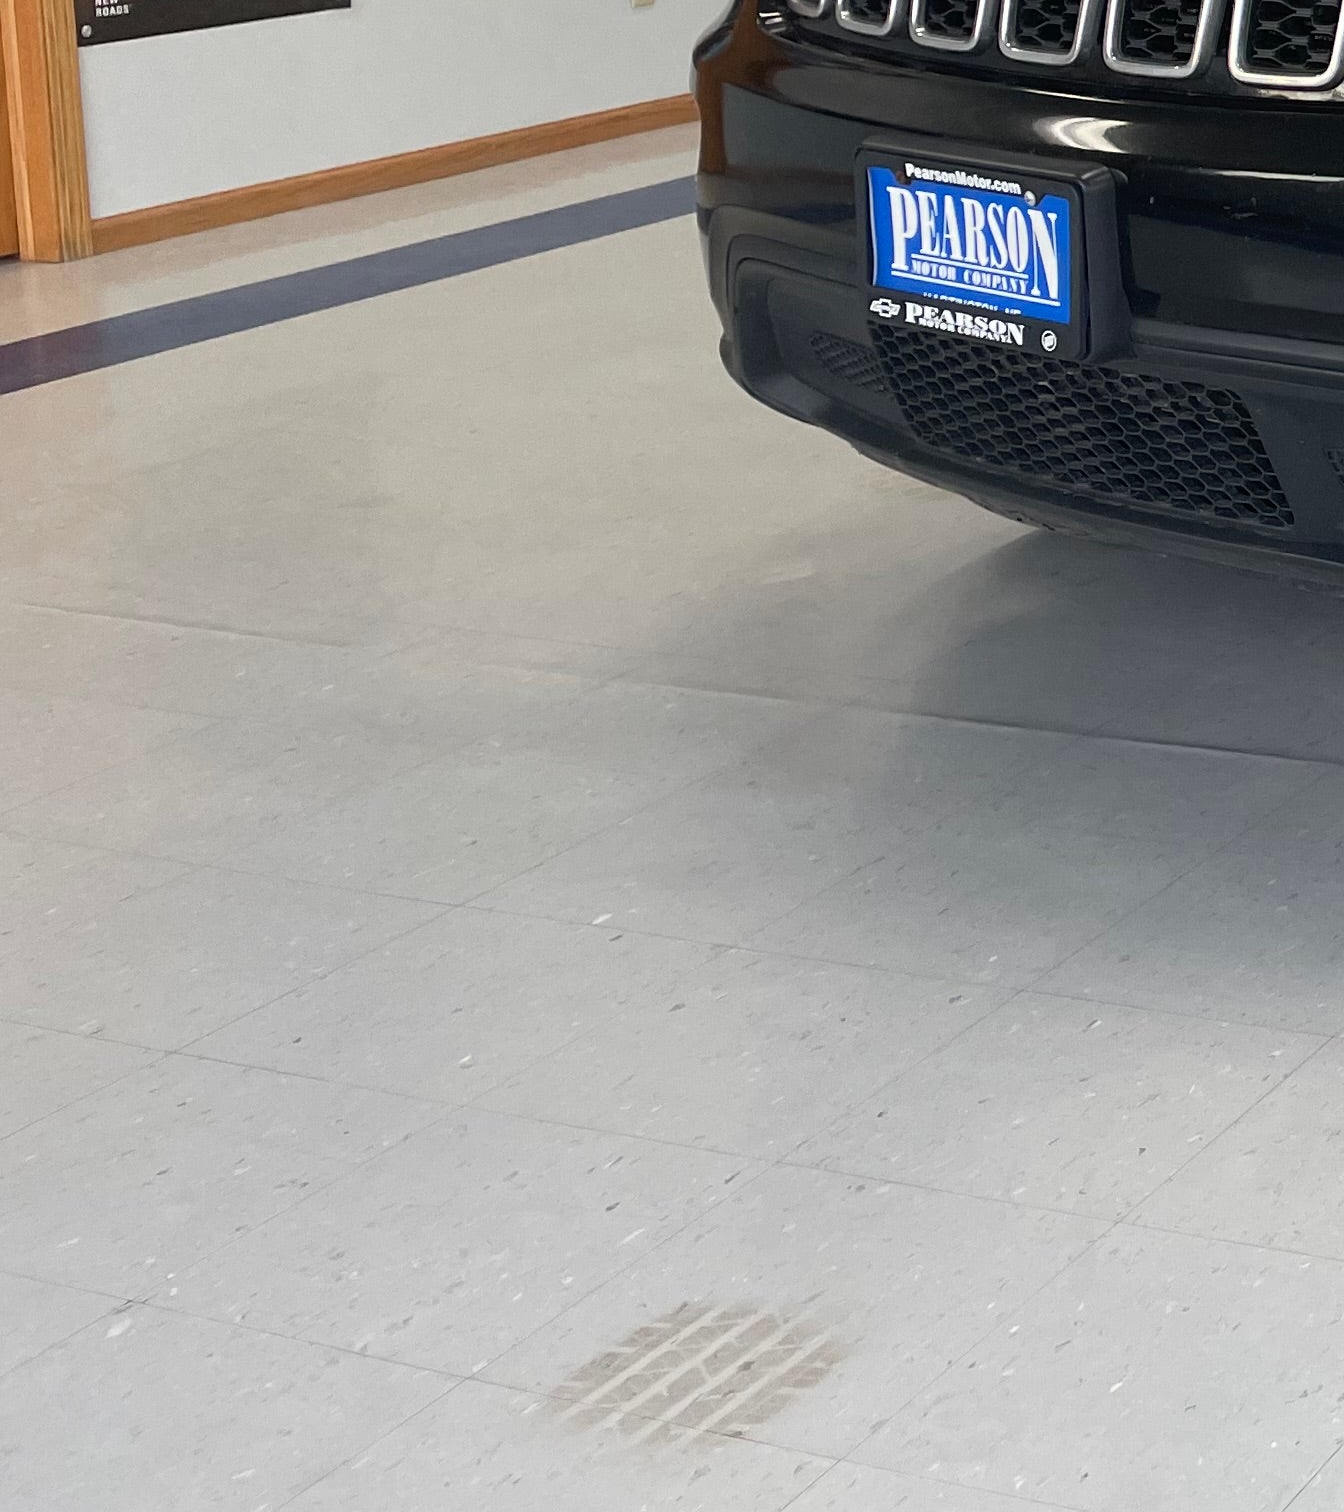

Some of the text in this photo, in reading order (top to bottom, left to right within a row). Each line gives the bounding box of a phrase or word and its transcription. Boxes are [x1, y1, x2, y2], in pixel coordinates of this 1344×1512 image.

[904, 162, 1022, 196] PearsonMotor.com
[886, 186, 1059, 300] PEARSON
[912, 260, 1029, 295] MOTOR COMPANY
[904, 301, 1025, 346] PEARSON
